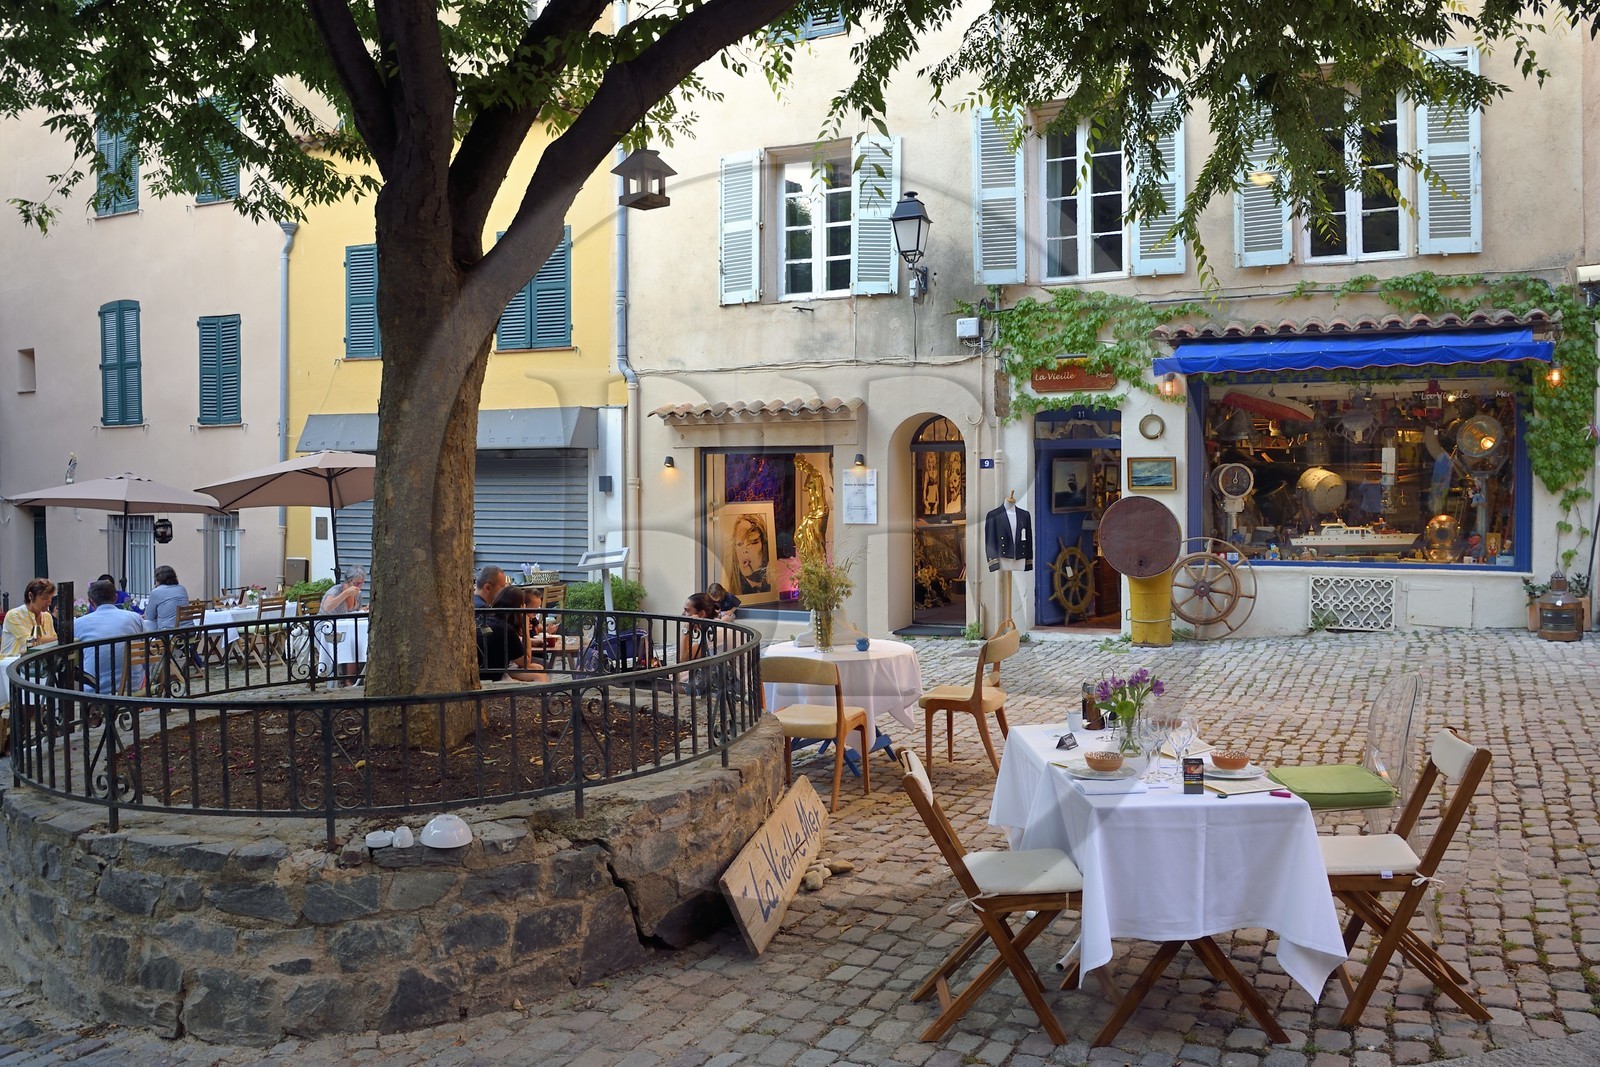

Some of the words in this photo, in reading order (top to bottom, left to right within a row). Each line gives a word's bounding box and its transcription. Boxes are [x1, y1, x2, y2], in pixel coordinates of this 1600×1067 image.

[1047, 371, 1076, 381] Vieille
[1095, 371, 1111, 379] Mer
[1436, 390, 1471, 400] Ville
[1496, 390, 1512, 398] Mer
[1077, 410, 1085, 418] 11
[984, 459, 990, 468] 9
[794, 797, 822, 847] Mer
